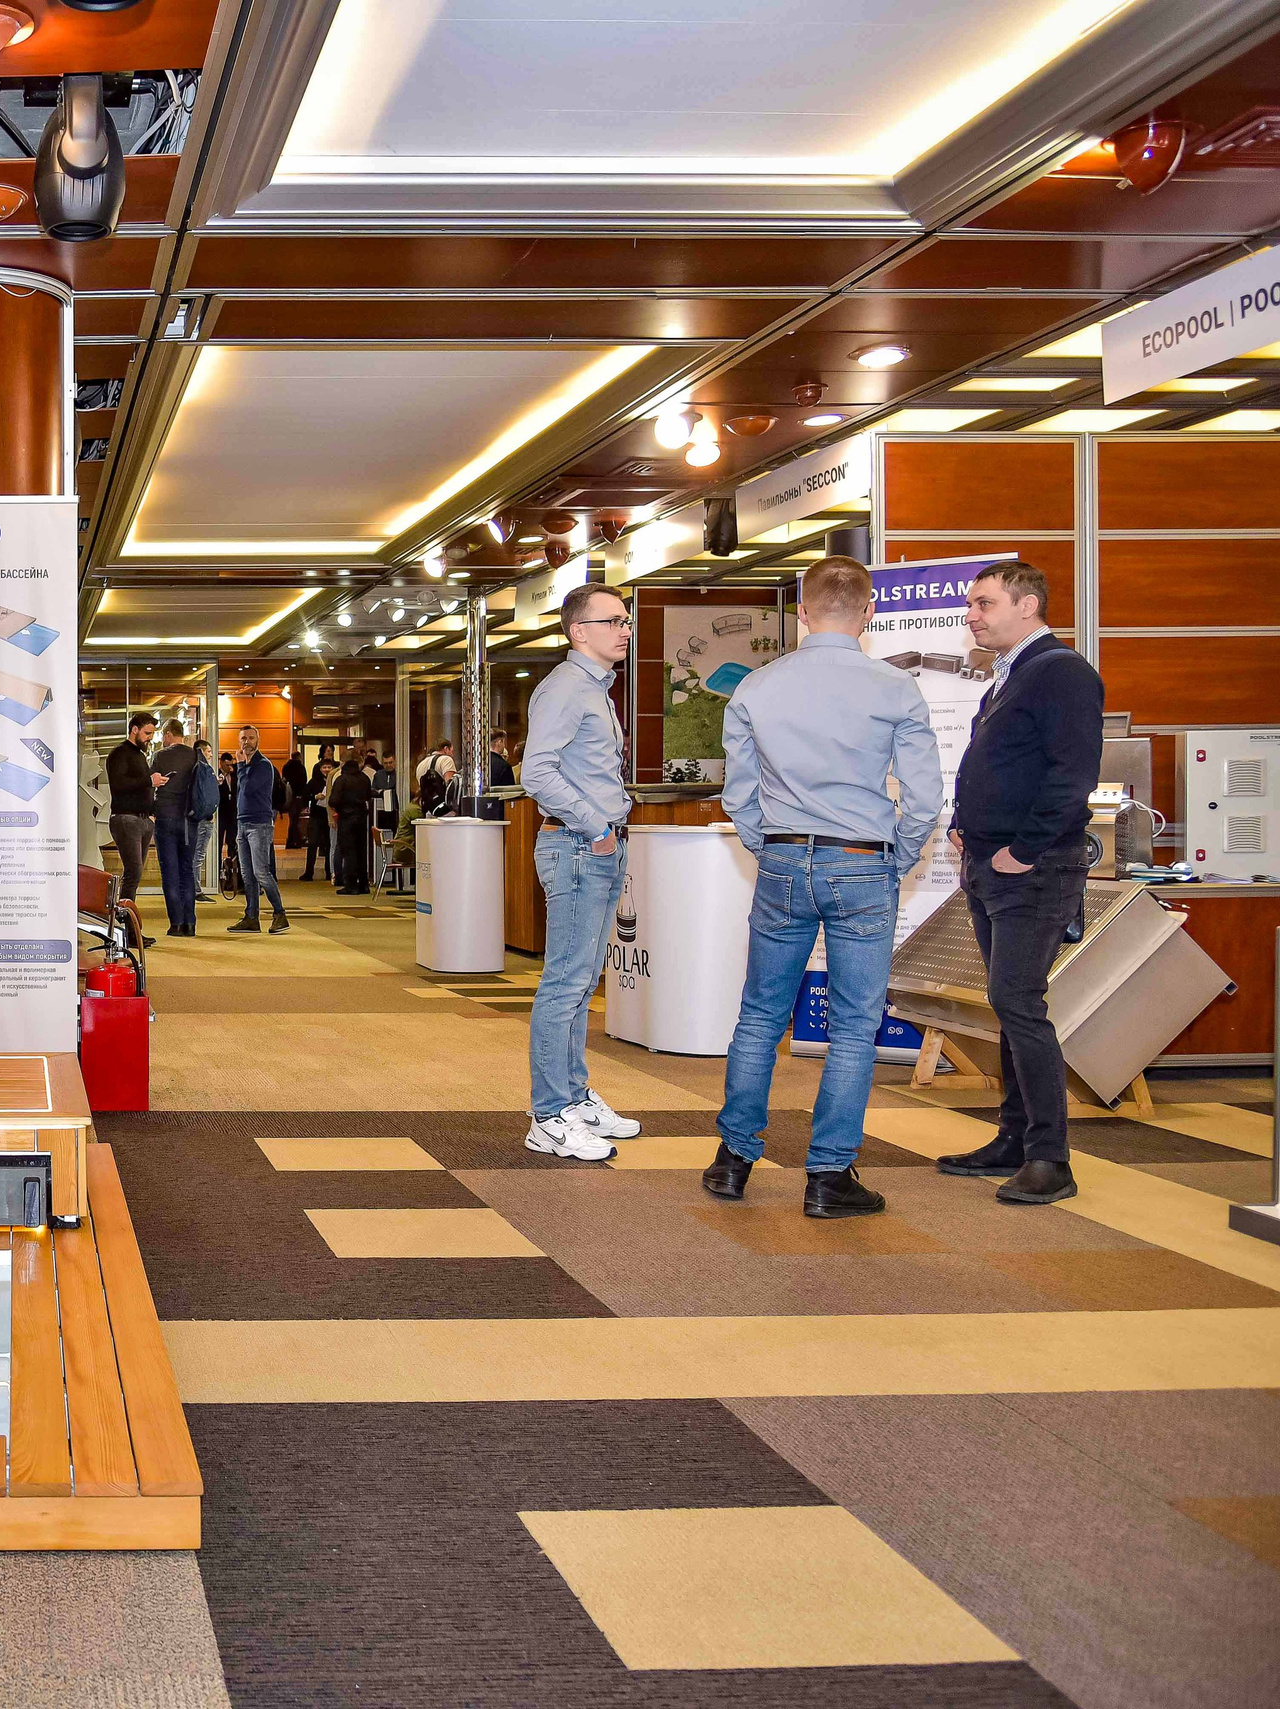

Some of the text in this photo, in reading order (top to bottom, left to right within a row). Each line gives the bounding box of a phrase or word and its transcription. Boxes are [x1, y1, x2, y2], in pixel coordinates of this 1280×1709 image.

[1142, 306, 1224, 358] ECOPOOL
[757, 462, 849, 513] Павильоны "SECCON"
[0, 566, 49, 580] БАССЕЙНА
[864, 614, 967, 633] ННЫЕ ПРОТИВОТО
[30, 741, 51, 760] NEW
[606, 943, 651, 977] POLAR
[619, 975, 635, 991] spa
